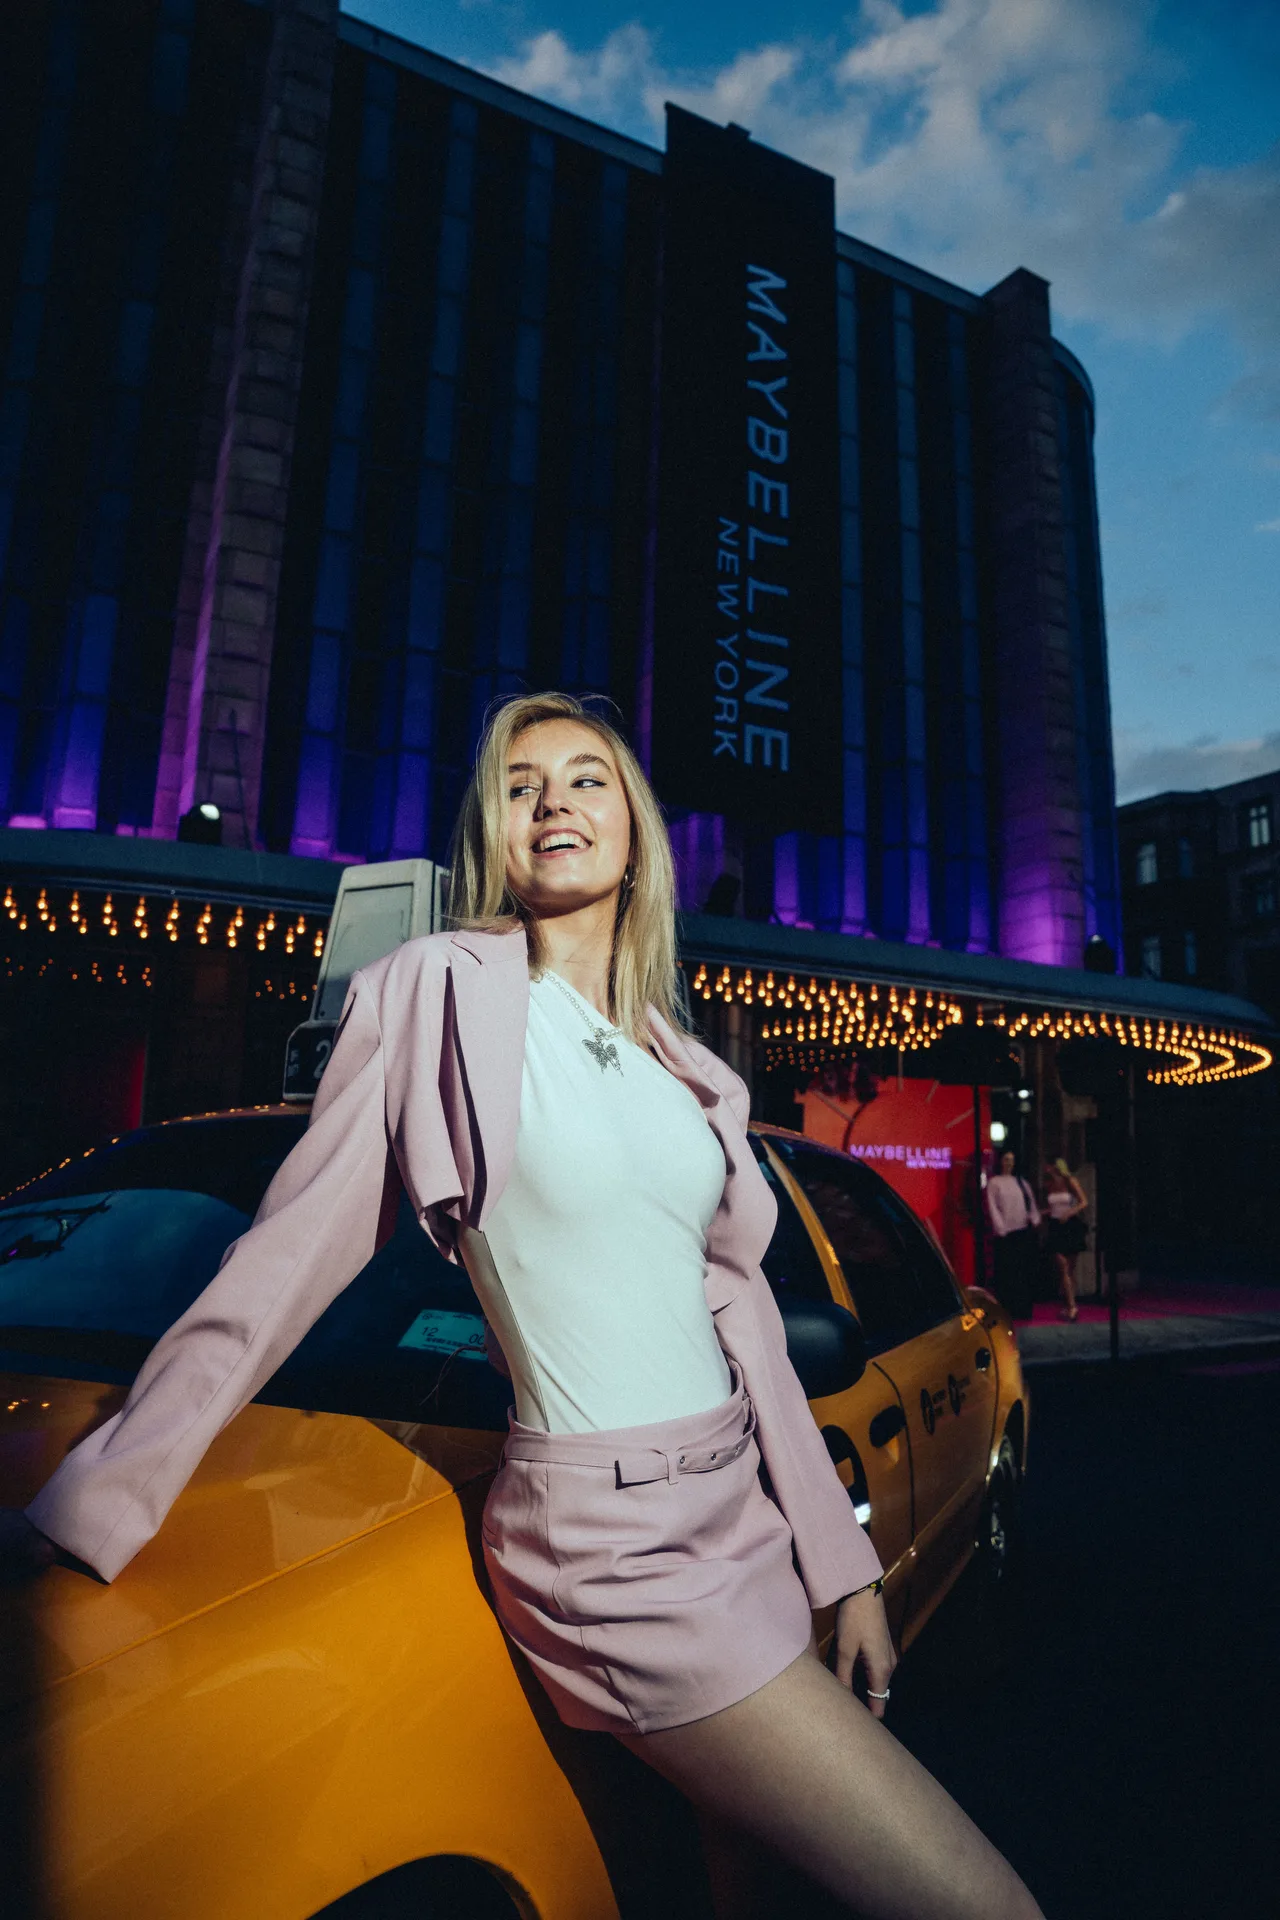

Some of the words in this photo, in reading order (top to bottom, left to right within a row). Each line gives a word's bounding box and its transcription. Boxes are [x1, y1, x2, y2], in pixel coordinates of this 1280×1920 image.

[715, 515, 741, 621] NEW
[744, 263, 791, 773] MAYBELLINE
[711, 632, 740, 758] YORK
[849, 1144, 952, 1161] MAYBELLINE
[422, 1326, 440, 1337] 12
